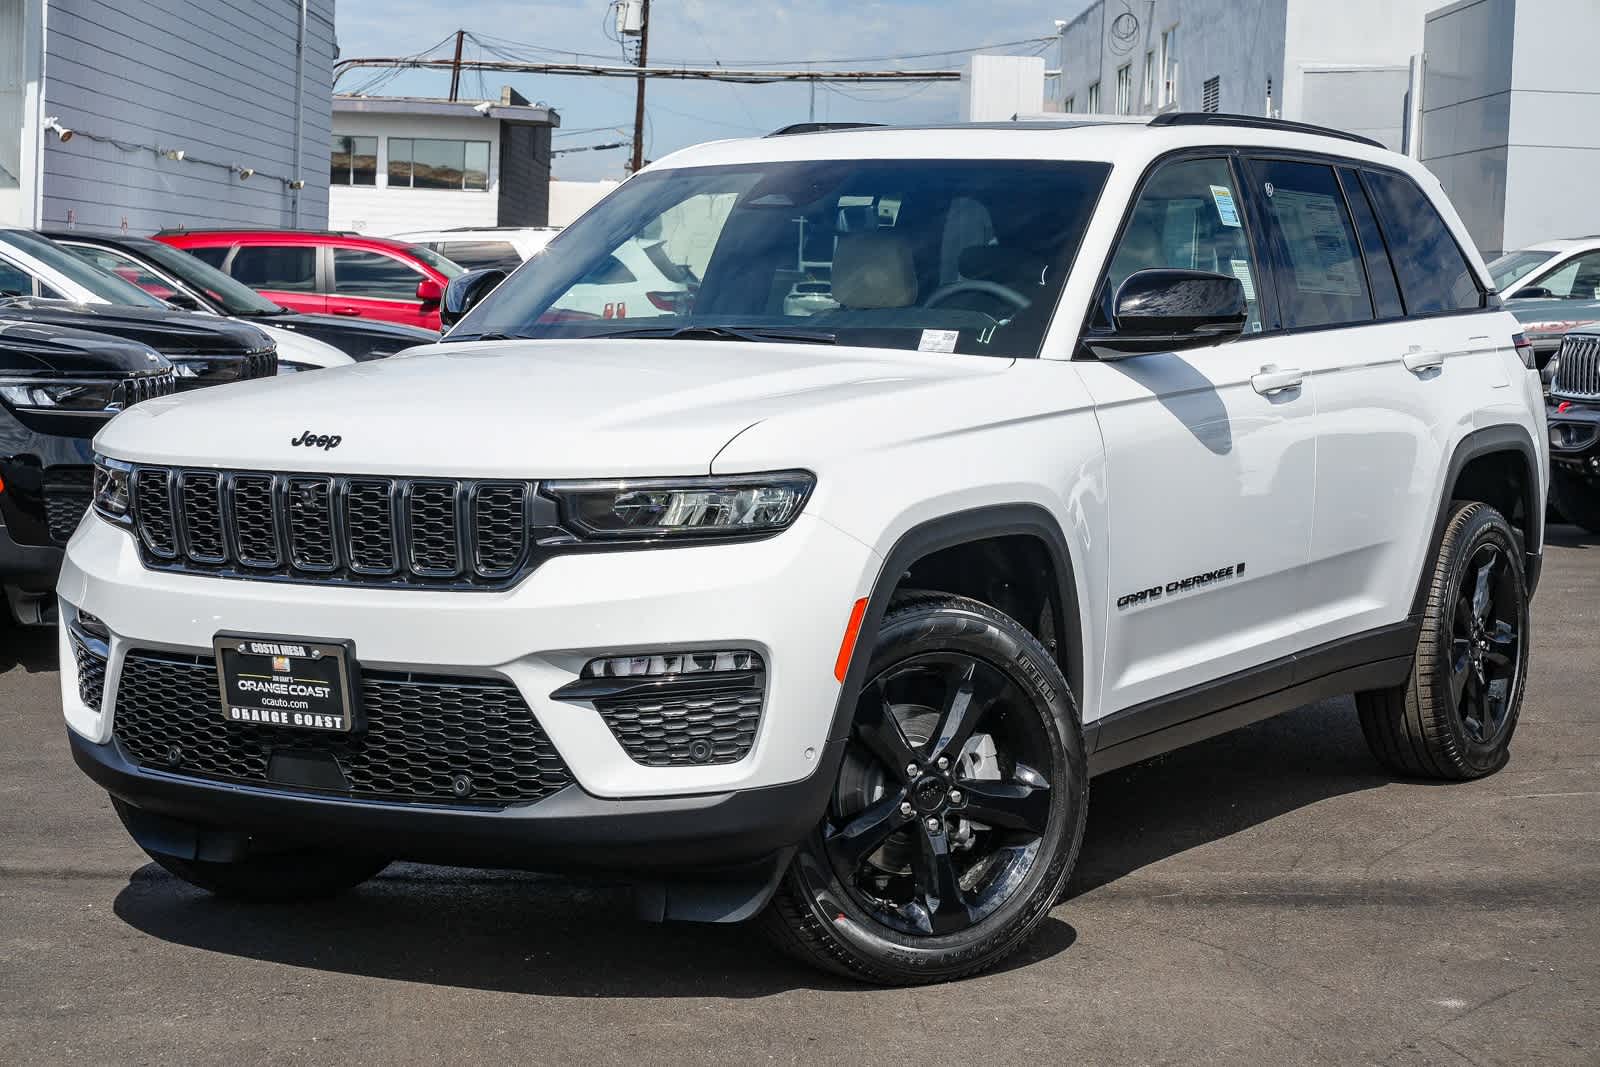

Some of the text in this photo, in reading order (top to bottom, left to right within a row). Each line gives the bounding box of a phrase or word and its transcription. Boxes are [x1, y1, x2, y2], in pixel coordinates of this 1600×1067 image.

[291, 430, 342, 451] Jeep
[1117, 566, 1234, 607] GRAND CHEROKEE
[251, 642, 306, 657] COSTA MESA
[238, 680, 331, 698] ORANGE COAST
[261, 697, 309, 709] ocauto.com
[231, 708, 342, 728] ORANGE COAST
